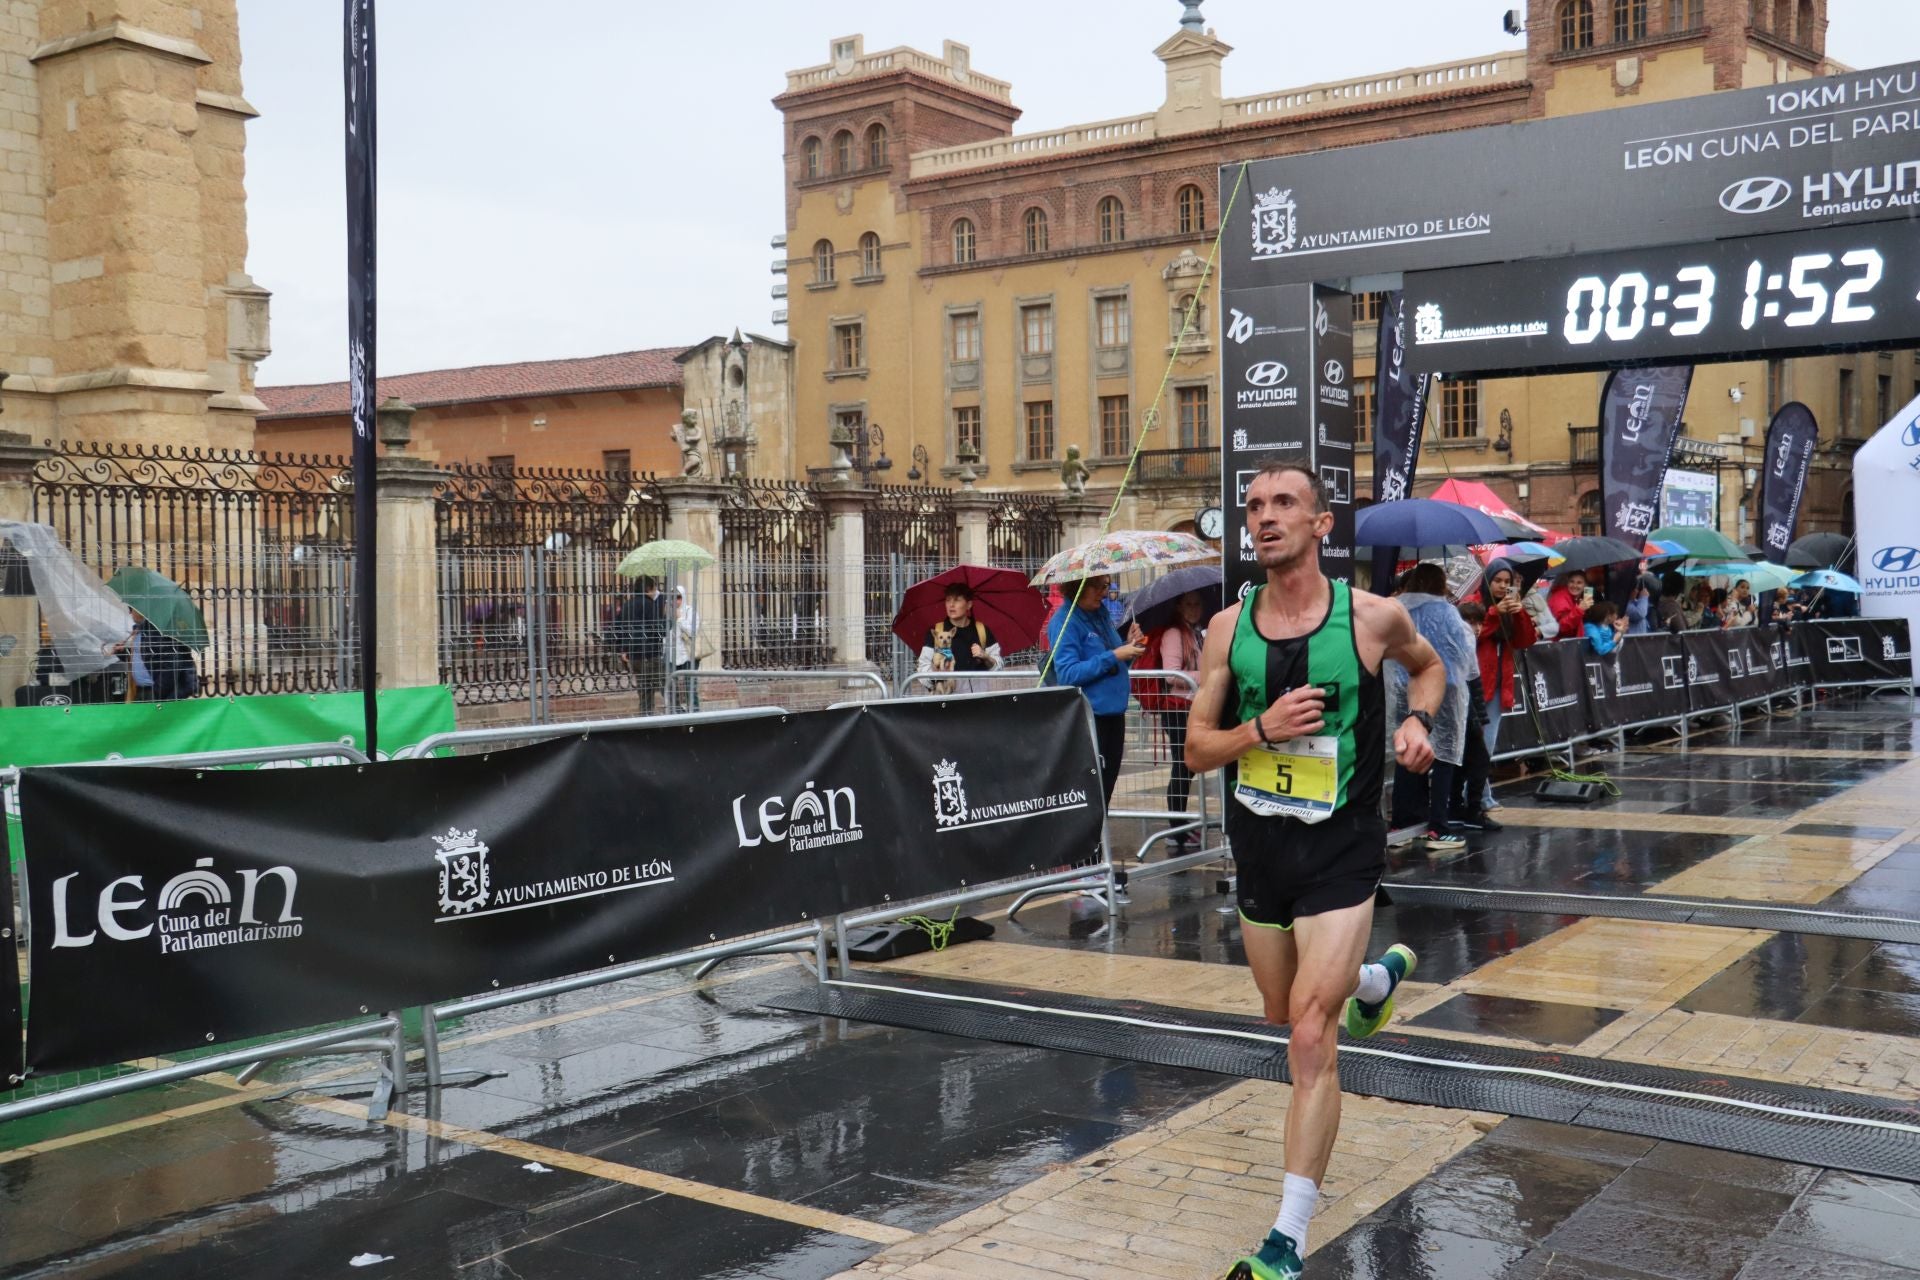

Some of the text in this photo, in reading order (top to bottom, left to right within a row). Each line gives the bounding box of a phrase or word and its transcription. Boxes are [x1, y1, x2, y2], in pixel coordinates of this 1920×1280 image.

[1766, 83, 1846, 115] 10KM
[1624, 141, 1693, 170] LEÓN
[1700, 130, 1780, 159] CUNA
[1789, 122, 1842, 148] DEL
[1803, 195, 1882, 218] Lemauto
[1300, 212, 1491, 249] AYUNTAMIENTO DE LEÓN
[1443, 320, 1548, 339] AYUNTAMIENTO DE LEÓN
[1237, 387, 1297, 403] HYUNDAI
[1320, 384, 1349, 401] HYUNDAI
[1865, 576, 1920, 589] HYUND
[1276, 763, 1292, 795] 5
[971, 788, 1087, 821] AYUNTAMIENTO DE LEÓN
[789, 818, 827, 838] Cuna del
[789, 829, 864, 853] Parlamentarismo
[494, 858, 673, 906] AYUNTAMIENTO DE LEÓN
[158, 907, 231, 934] Cuna del
[160, 922, 303, 954] Parlamentarismo
